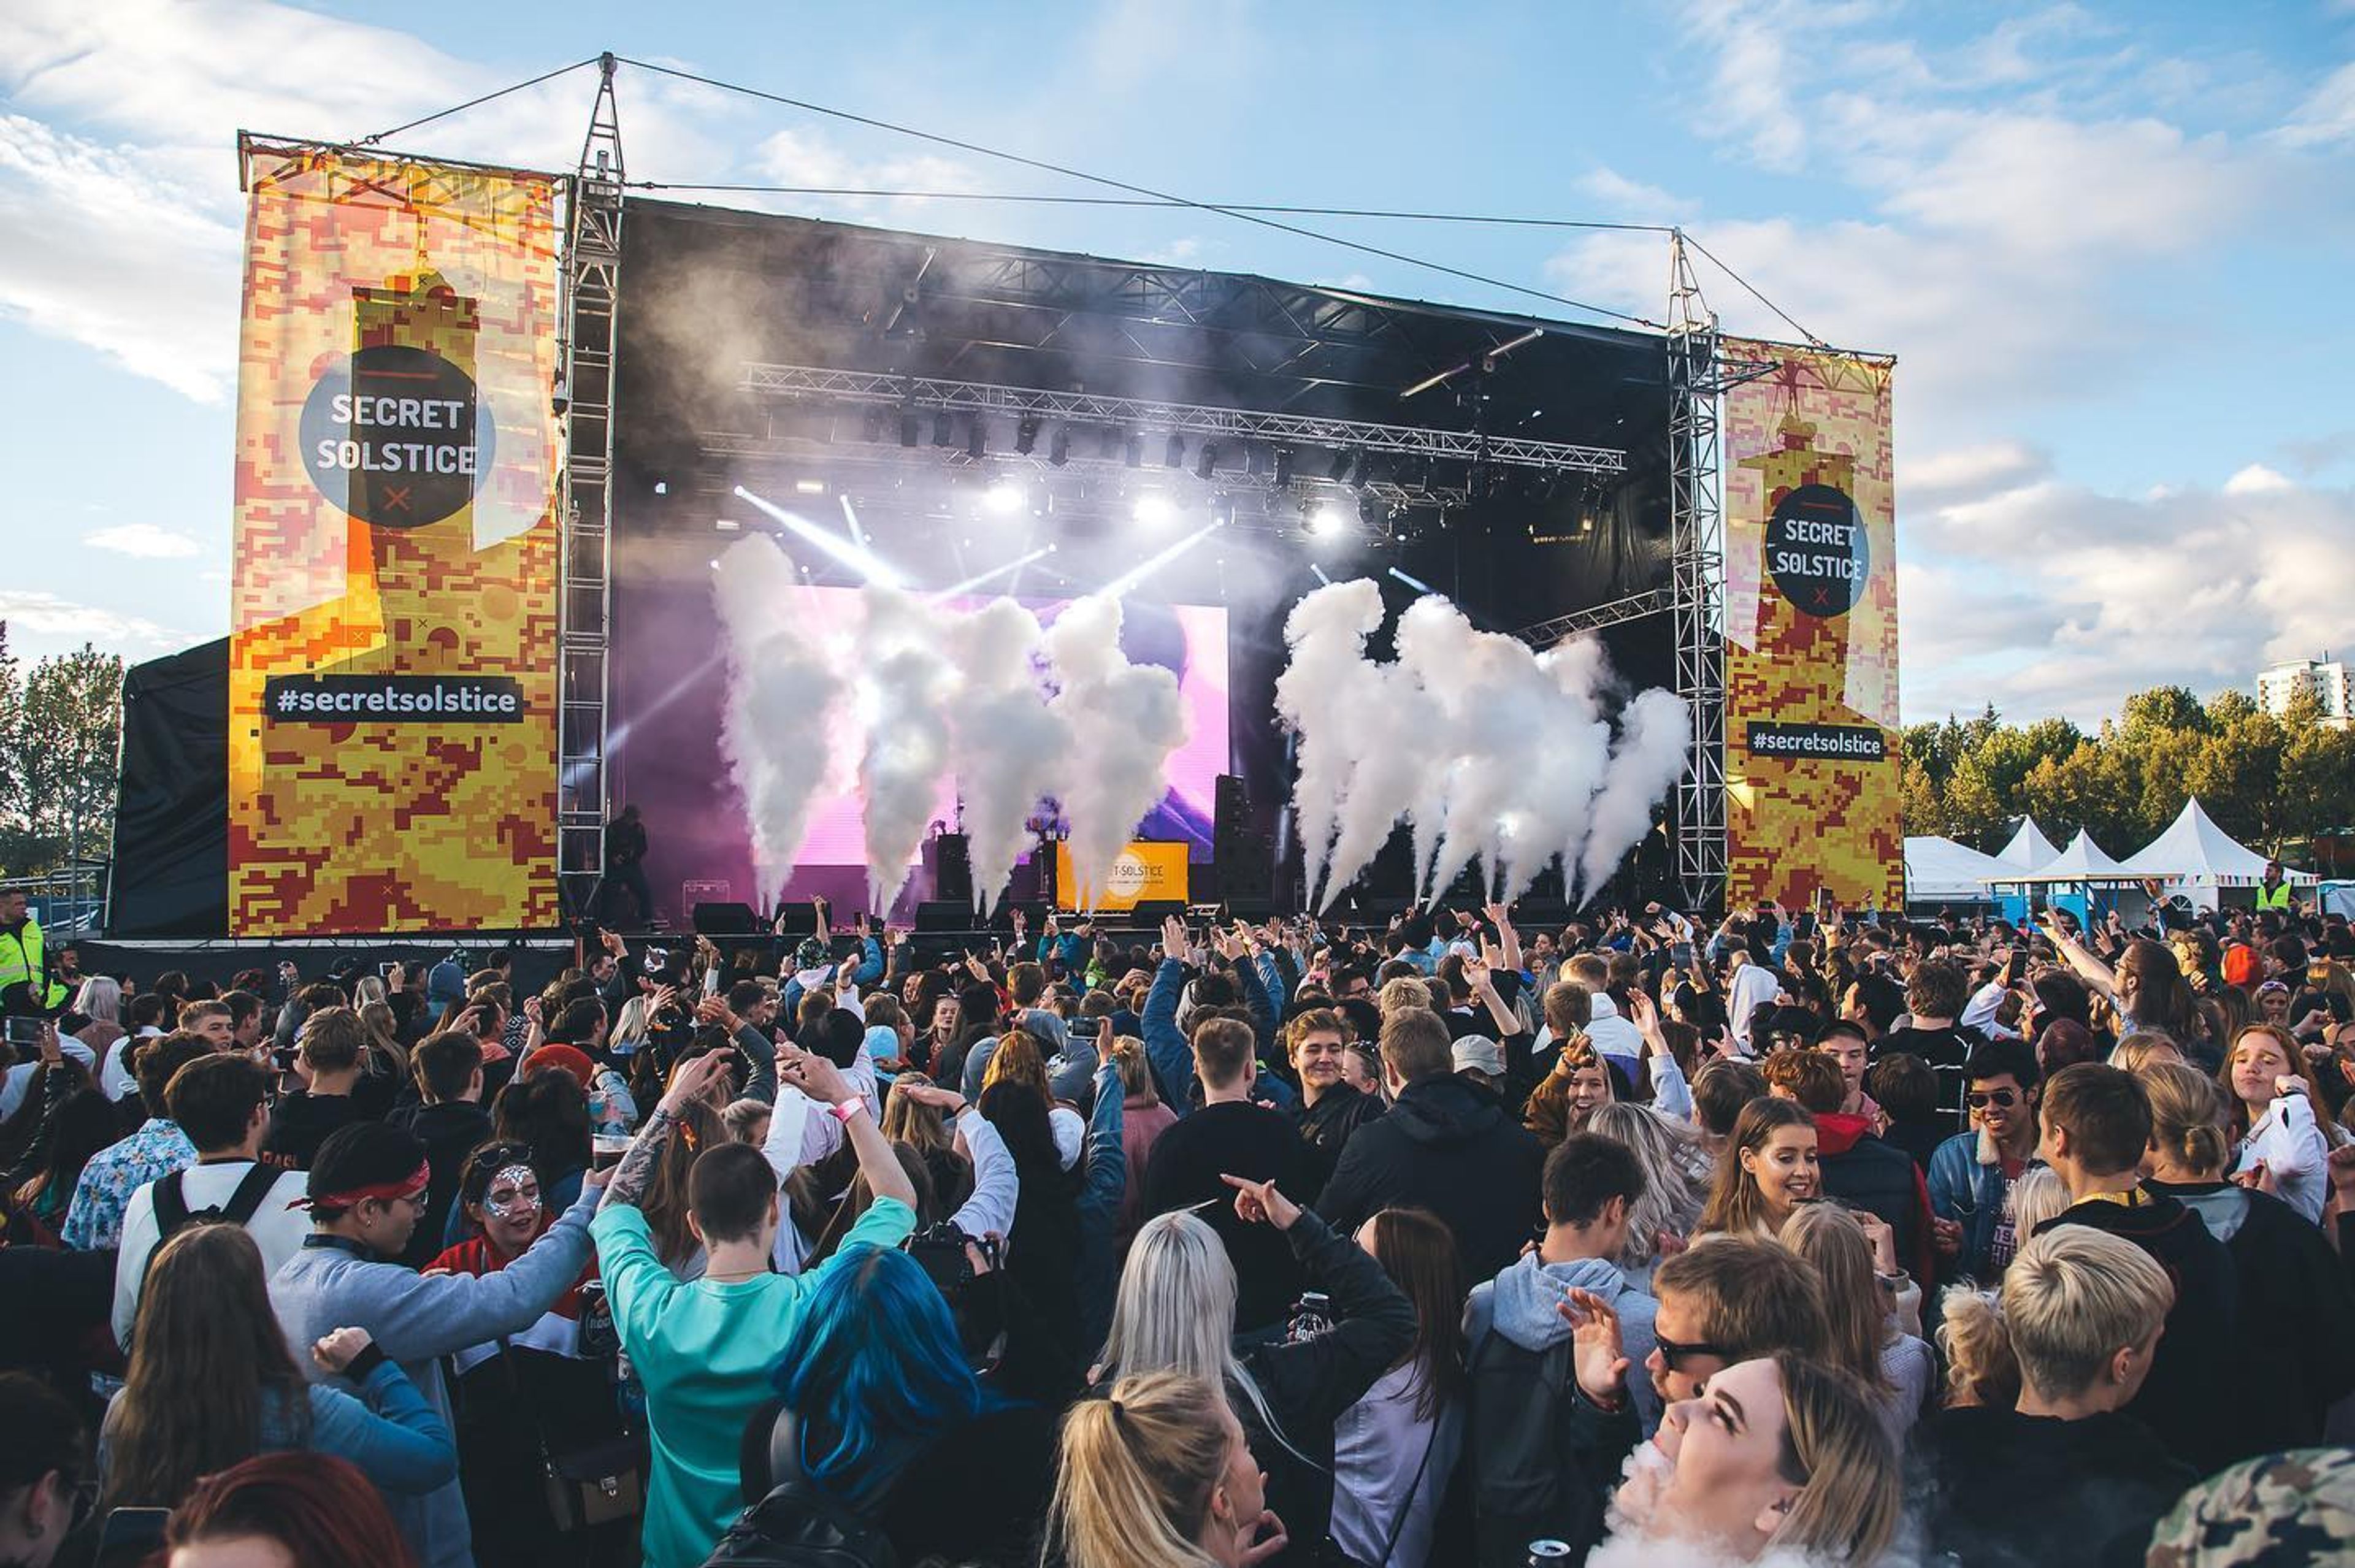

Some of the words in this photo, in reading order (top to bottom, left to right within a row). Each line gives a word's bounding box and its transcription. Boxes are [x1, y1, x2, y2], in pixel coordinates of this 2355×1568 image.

[331, 394, 464, 429] SECRET
[316, 439, 478, 475] SOLSTICE
[1785, 519, 1857, 547] SECRET
[1776, 551, 1862, 580] SOLSTICE
[277, 684, 516, 713] #secretsolstice
[1753, 732, 1880, 754] #secretsolstice
